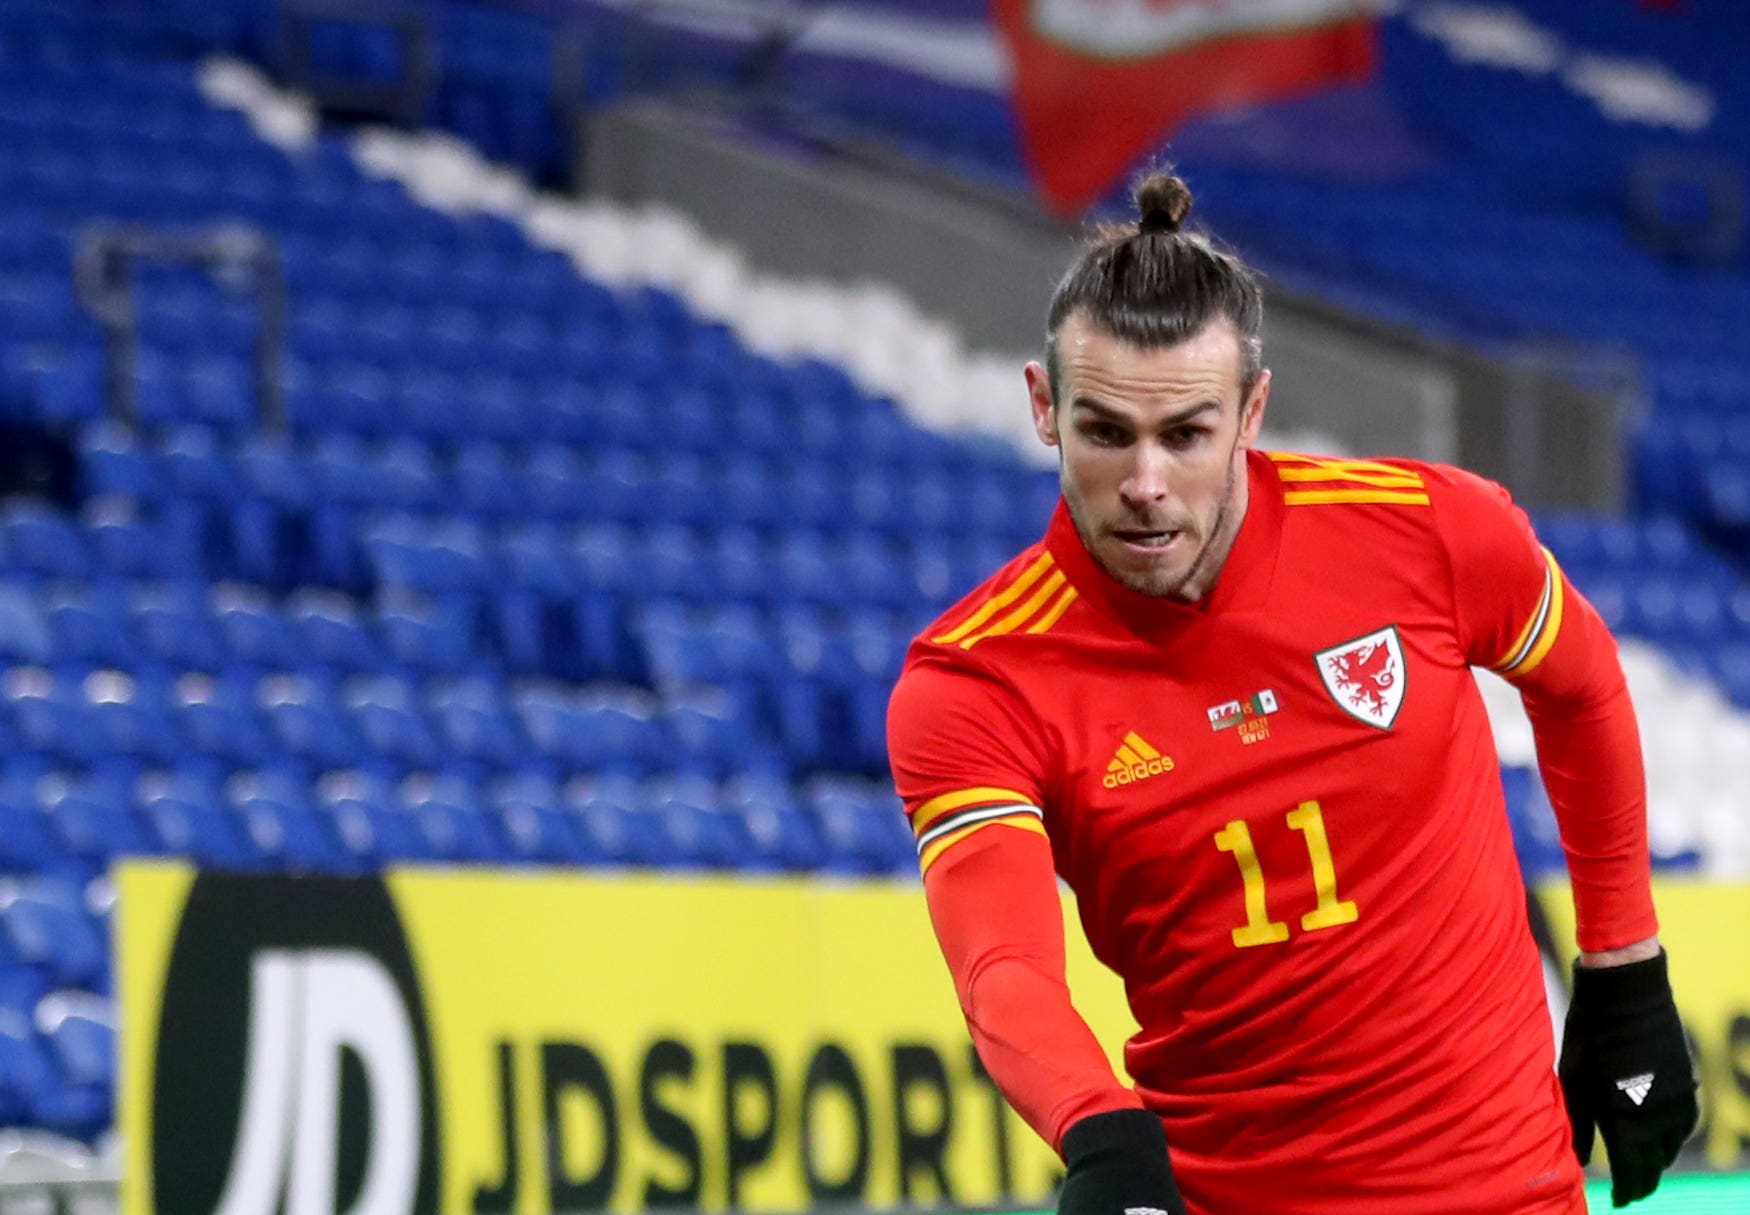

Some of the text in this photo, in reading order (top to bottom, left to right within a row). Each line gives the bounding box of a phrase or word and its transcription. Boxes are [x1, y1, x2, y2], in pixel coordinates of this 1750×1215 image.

[1102, 755, 1175, 789] adidas
[1213, 799, 1359, 948] 11
[472, 1036, 1066, 1215] JDSPORT
